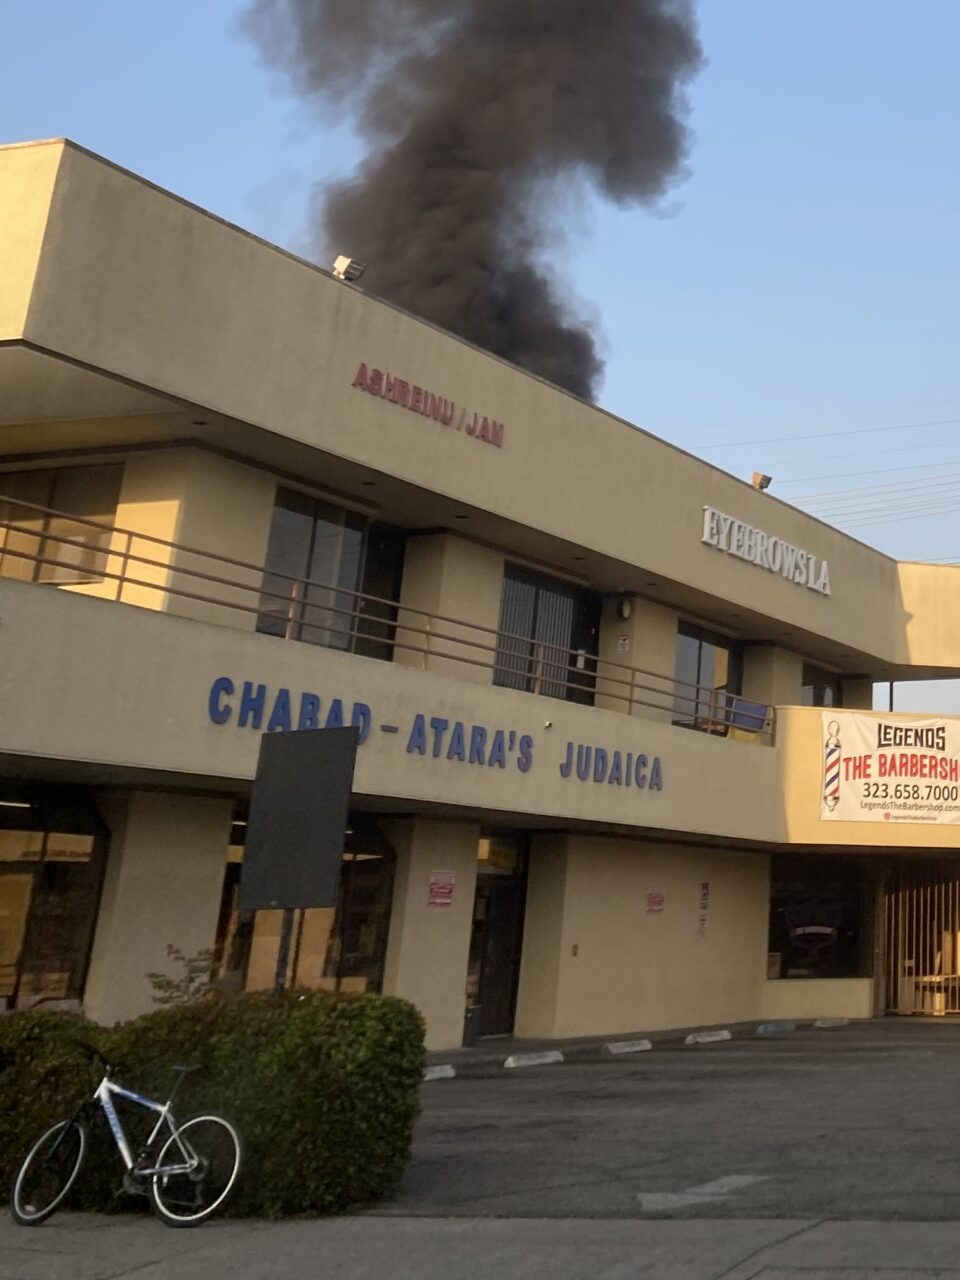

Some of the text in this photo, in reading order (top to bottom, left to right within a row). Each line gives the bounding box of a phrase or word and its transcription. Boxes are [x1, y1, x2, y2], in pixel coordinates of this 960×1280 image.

[208, 677, 372, 746] CHABAD
[406, 714, 534, 773] ATARA'S
[560, 742, 663, 791] JUDAICA
[876, 723, 946, 752] LEGENDS
[843, 755, 872, 782] THE
[862, 783, 959, 801] 323.658.7000
